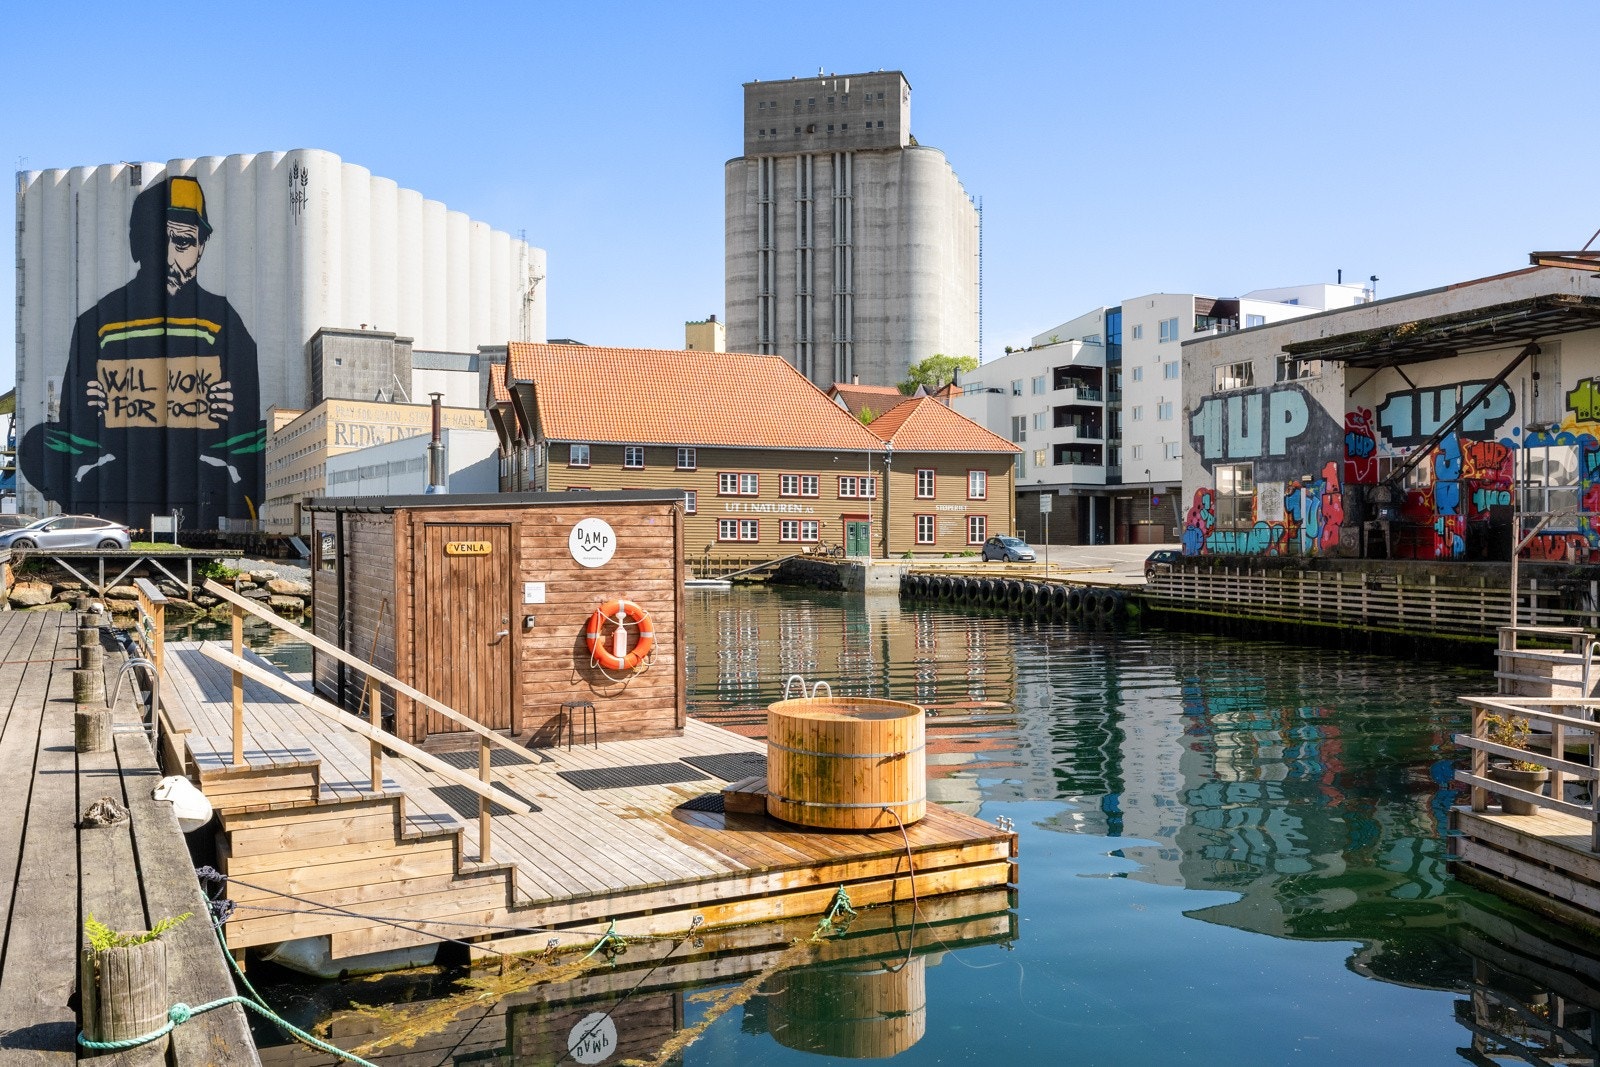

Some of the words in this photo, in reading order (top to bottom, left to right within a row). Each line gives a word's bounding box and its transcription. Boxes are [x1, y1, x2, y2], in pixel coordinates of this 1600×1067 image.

[102, 366, 157, 393] WILL
[112, 396, 157, 423] FOR
[166, 399, 209, 417] FOOD
[1380, 384, 1511, 438] 1UP
[1192, 390, 1309, 460] 1UP
[1345, 433, 1375, 458] 1UP
[1471, 441, 1509, 470] 1UP
[725, 502, 741, 512] UT
[744, 503, 748, 512] I
[751, 503, 803, 513] NATUREN
[453, 544, 485, 552] VENLA
[577, 528, 608, 548] DAMP
